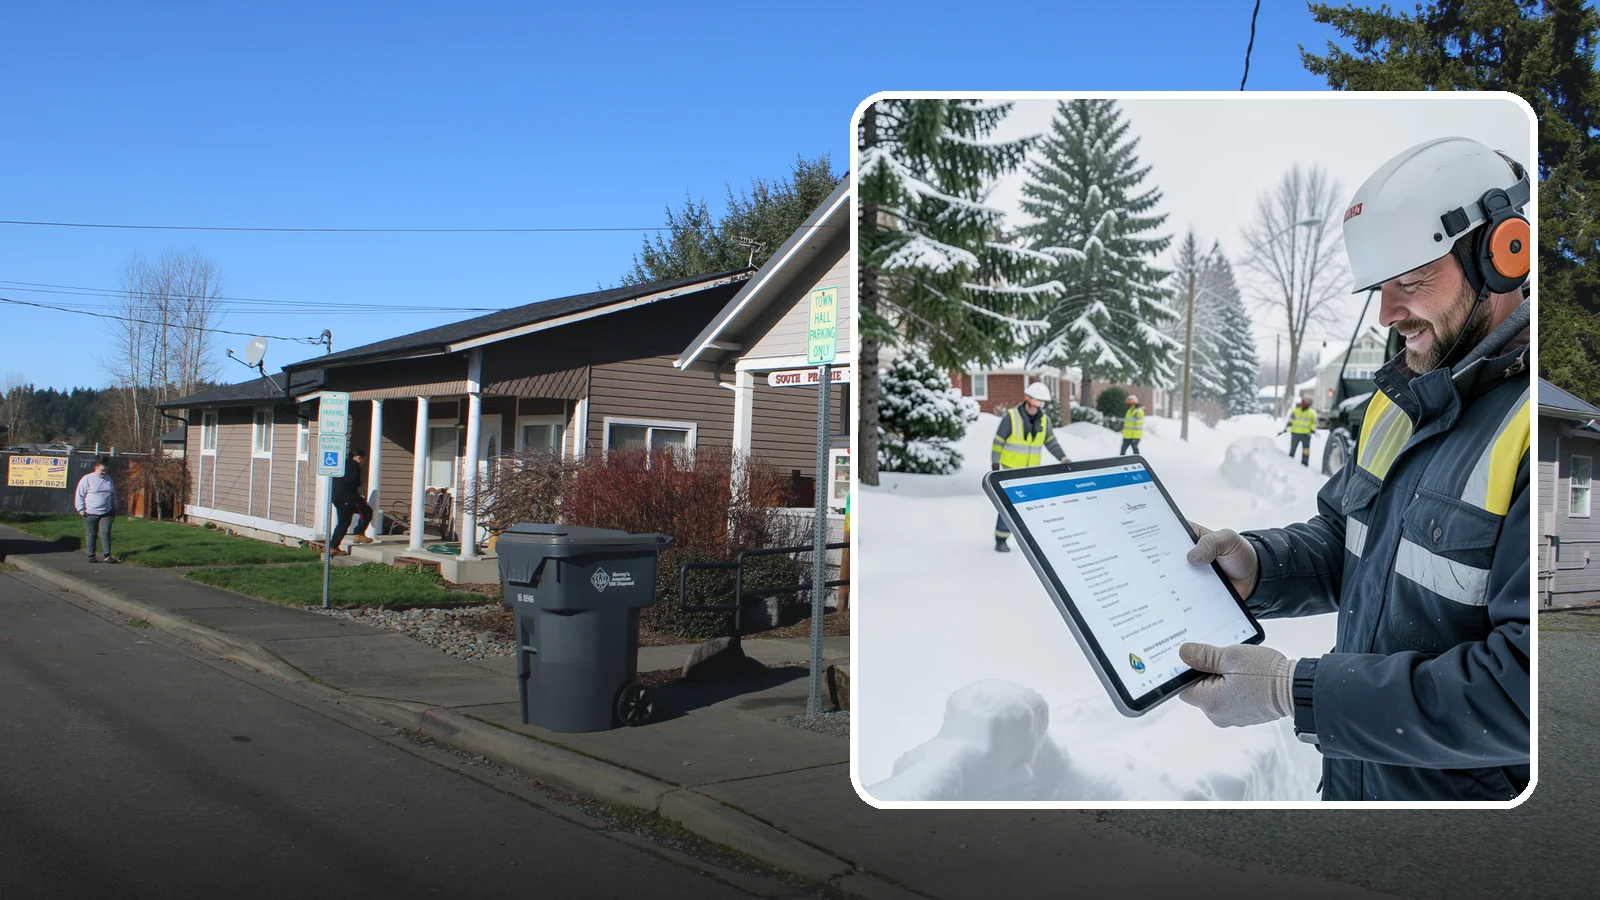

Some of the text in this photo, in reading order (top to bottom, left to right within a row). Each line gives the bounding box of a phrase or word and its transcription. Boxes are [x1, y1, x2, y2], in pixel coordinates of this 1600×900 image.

[815, 294, 833, 307] TOWN
[814, 311, 831, 324] HALL
[810, 326, 836, 341] PARKING
[813, 344, 831, 357] ONLY
[775, 373, 801, 384] SOUTH
